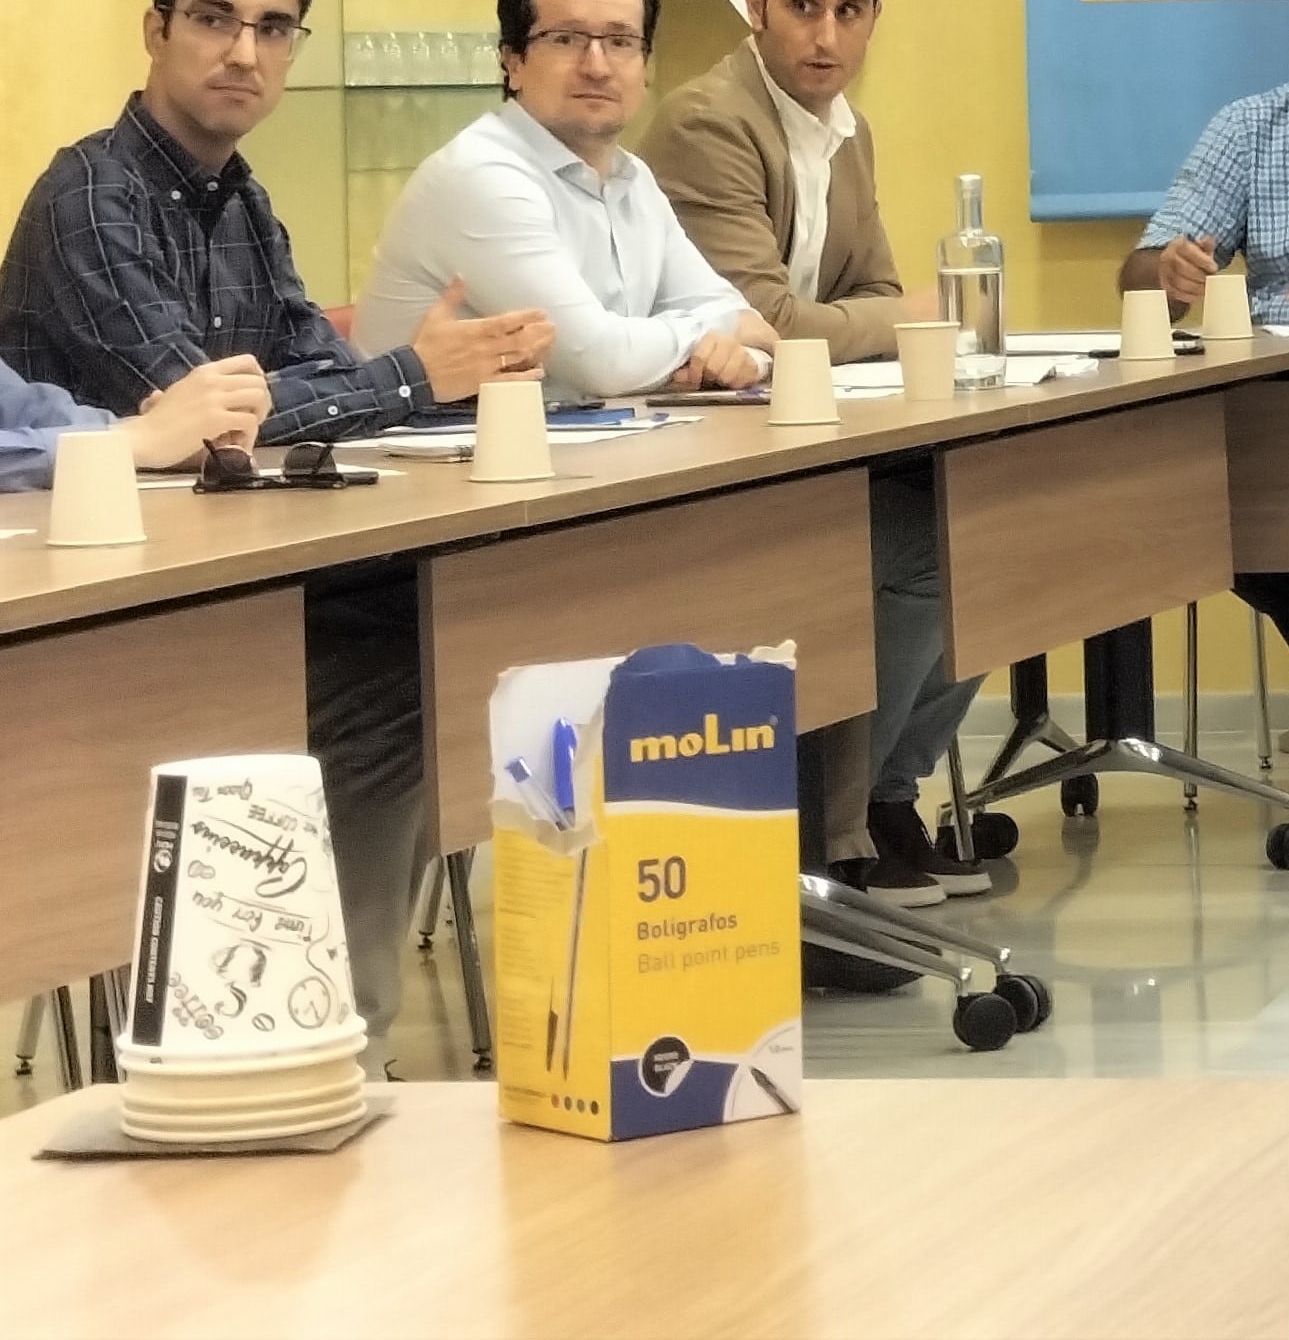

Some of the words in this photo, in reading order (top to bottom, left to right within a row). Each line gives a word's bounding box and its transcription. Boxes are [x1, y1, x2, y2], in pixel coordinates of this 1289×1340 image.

[637, 855, 686, 903] 50
[637, 951, 676, 974] Ball
[682, 944, 728, 973] point
[735, 940, 780, 964] pens
